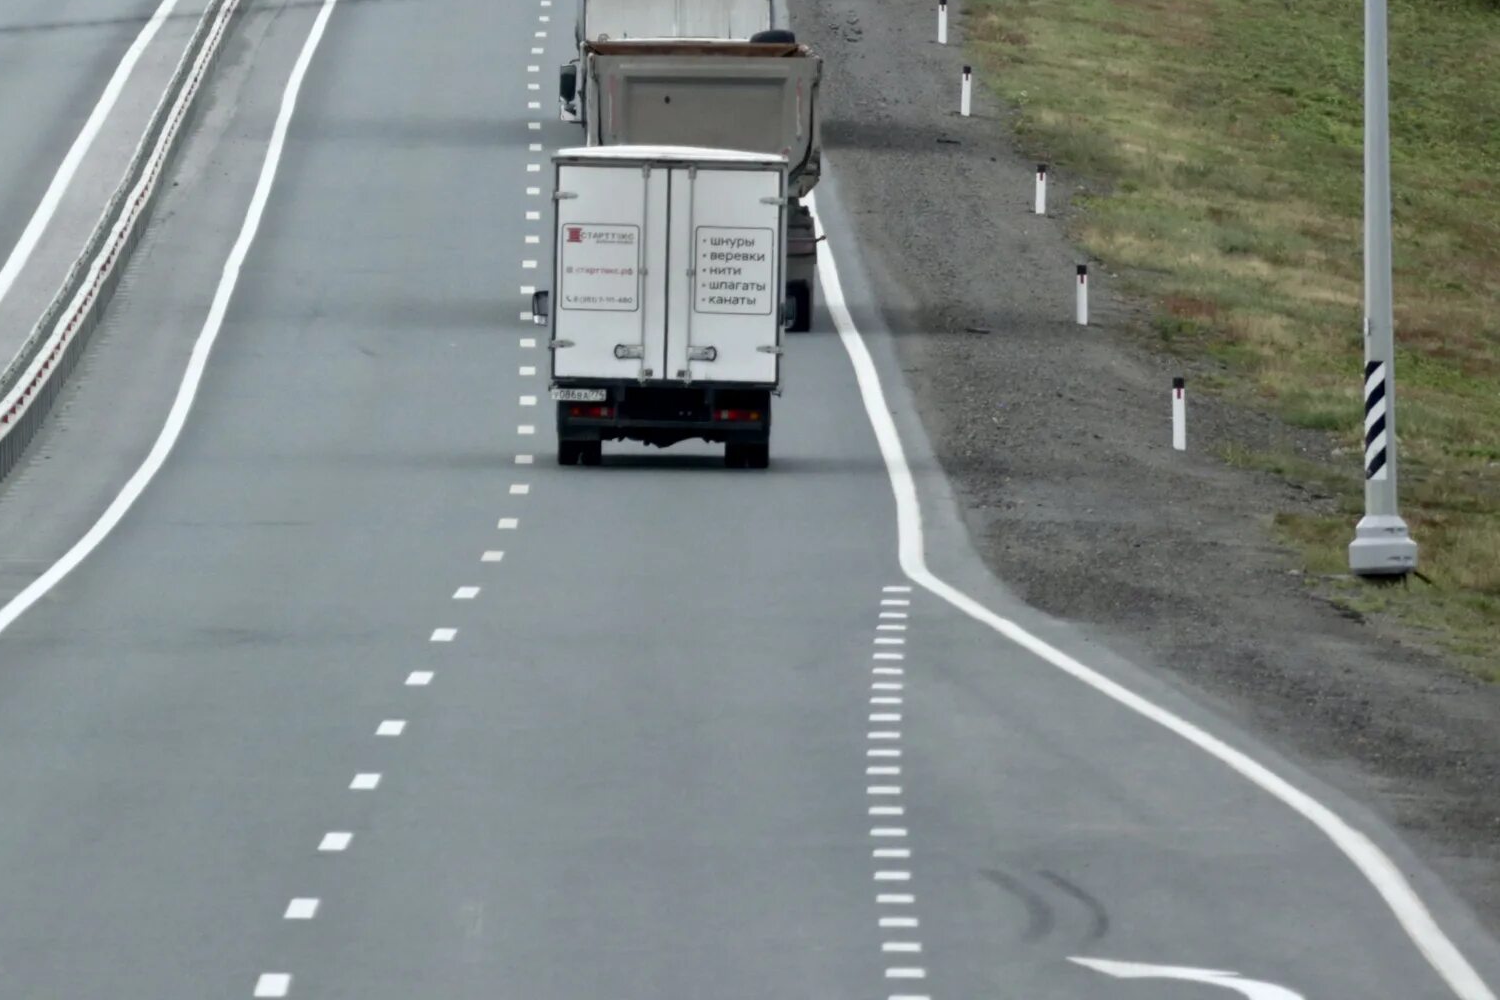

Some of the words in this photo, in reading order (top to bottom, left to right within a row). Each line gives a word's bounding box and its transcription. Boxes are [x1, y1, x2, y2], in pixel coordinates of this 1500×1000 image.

[710, 237, 755, 248] шнуры
[710, 251, 765, 263] веревки
[709, 266, 742, 276] нити
[708, 280, 766, 291] шпагаты
[708, 295, 757, 305] канаты
